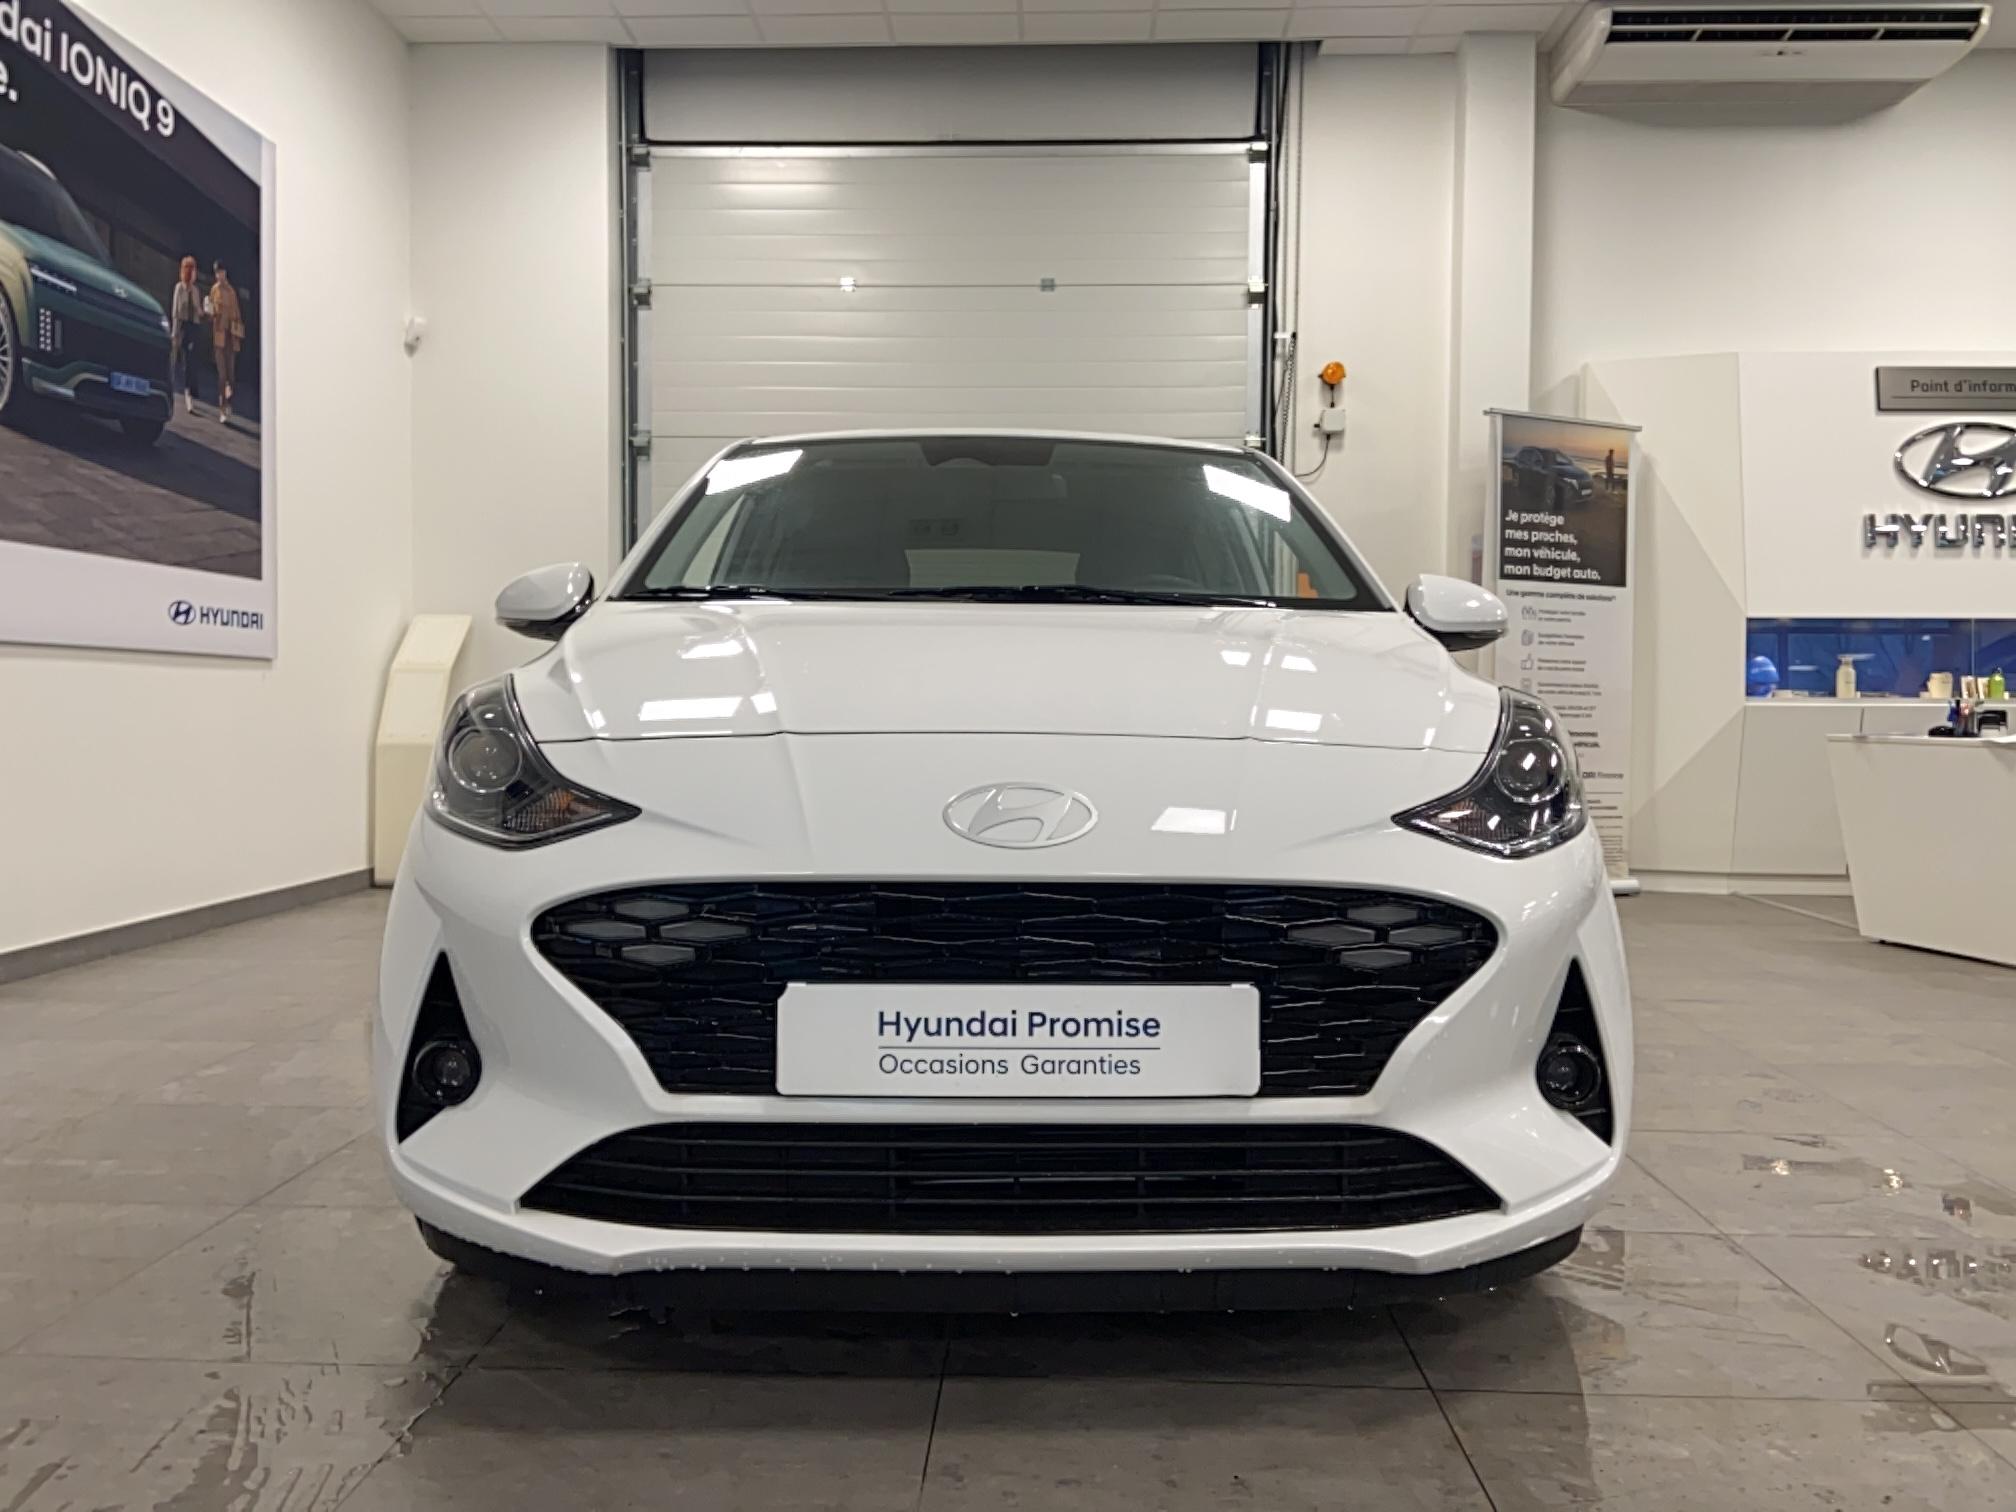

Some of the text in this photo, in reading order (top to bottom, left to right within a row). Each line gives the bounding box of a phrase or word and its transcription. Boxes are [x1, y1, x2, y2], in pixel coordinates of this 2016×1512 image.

[60, 31, 151, 132] IONIQ
[157, 98, 176, 137] 9
[1910, 379, 1949, 393] Point
[1505, 510, 1565, 526] Je protège
[1505, 529, 1577, 545] mes proches,
[1863, 513, 2016, 548] HYUN
[1504, 546, 1531, 559] mon
[1504, 564, 1531, 576] mon
[1533, 564, 1572, 580] budget
[199, 606, 264, 630] HYUNDAI
[878, 1010, 1161, 1042] Hyundai Promise
[878, 1053, 1141, 1076] Occasions Garanties
